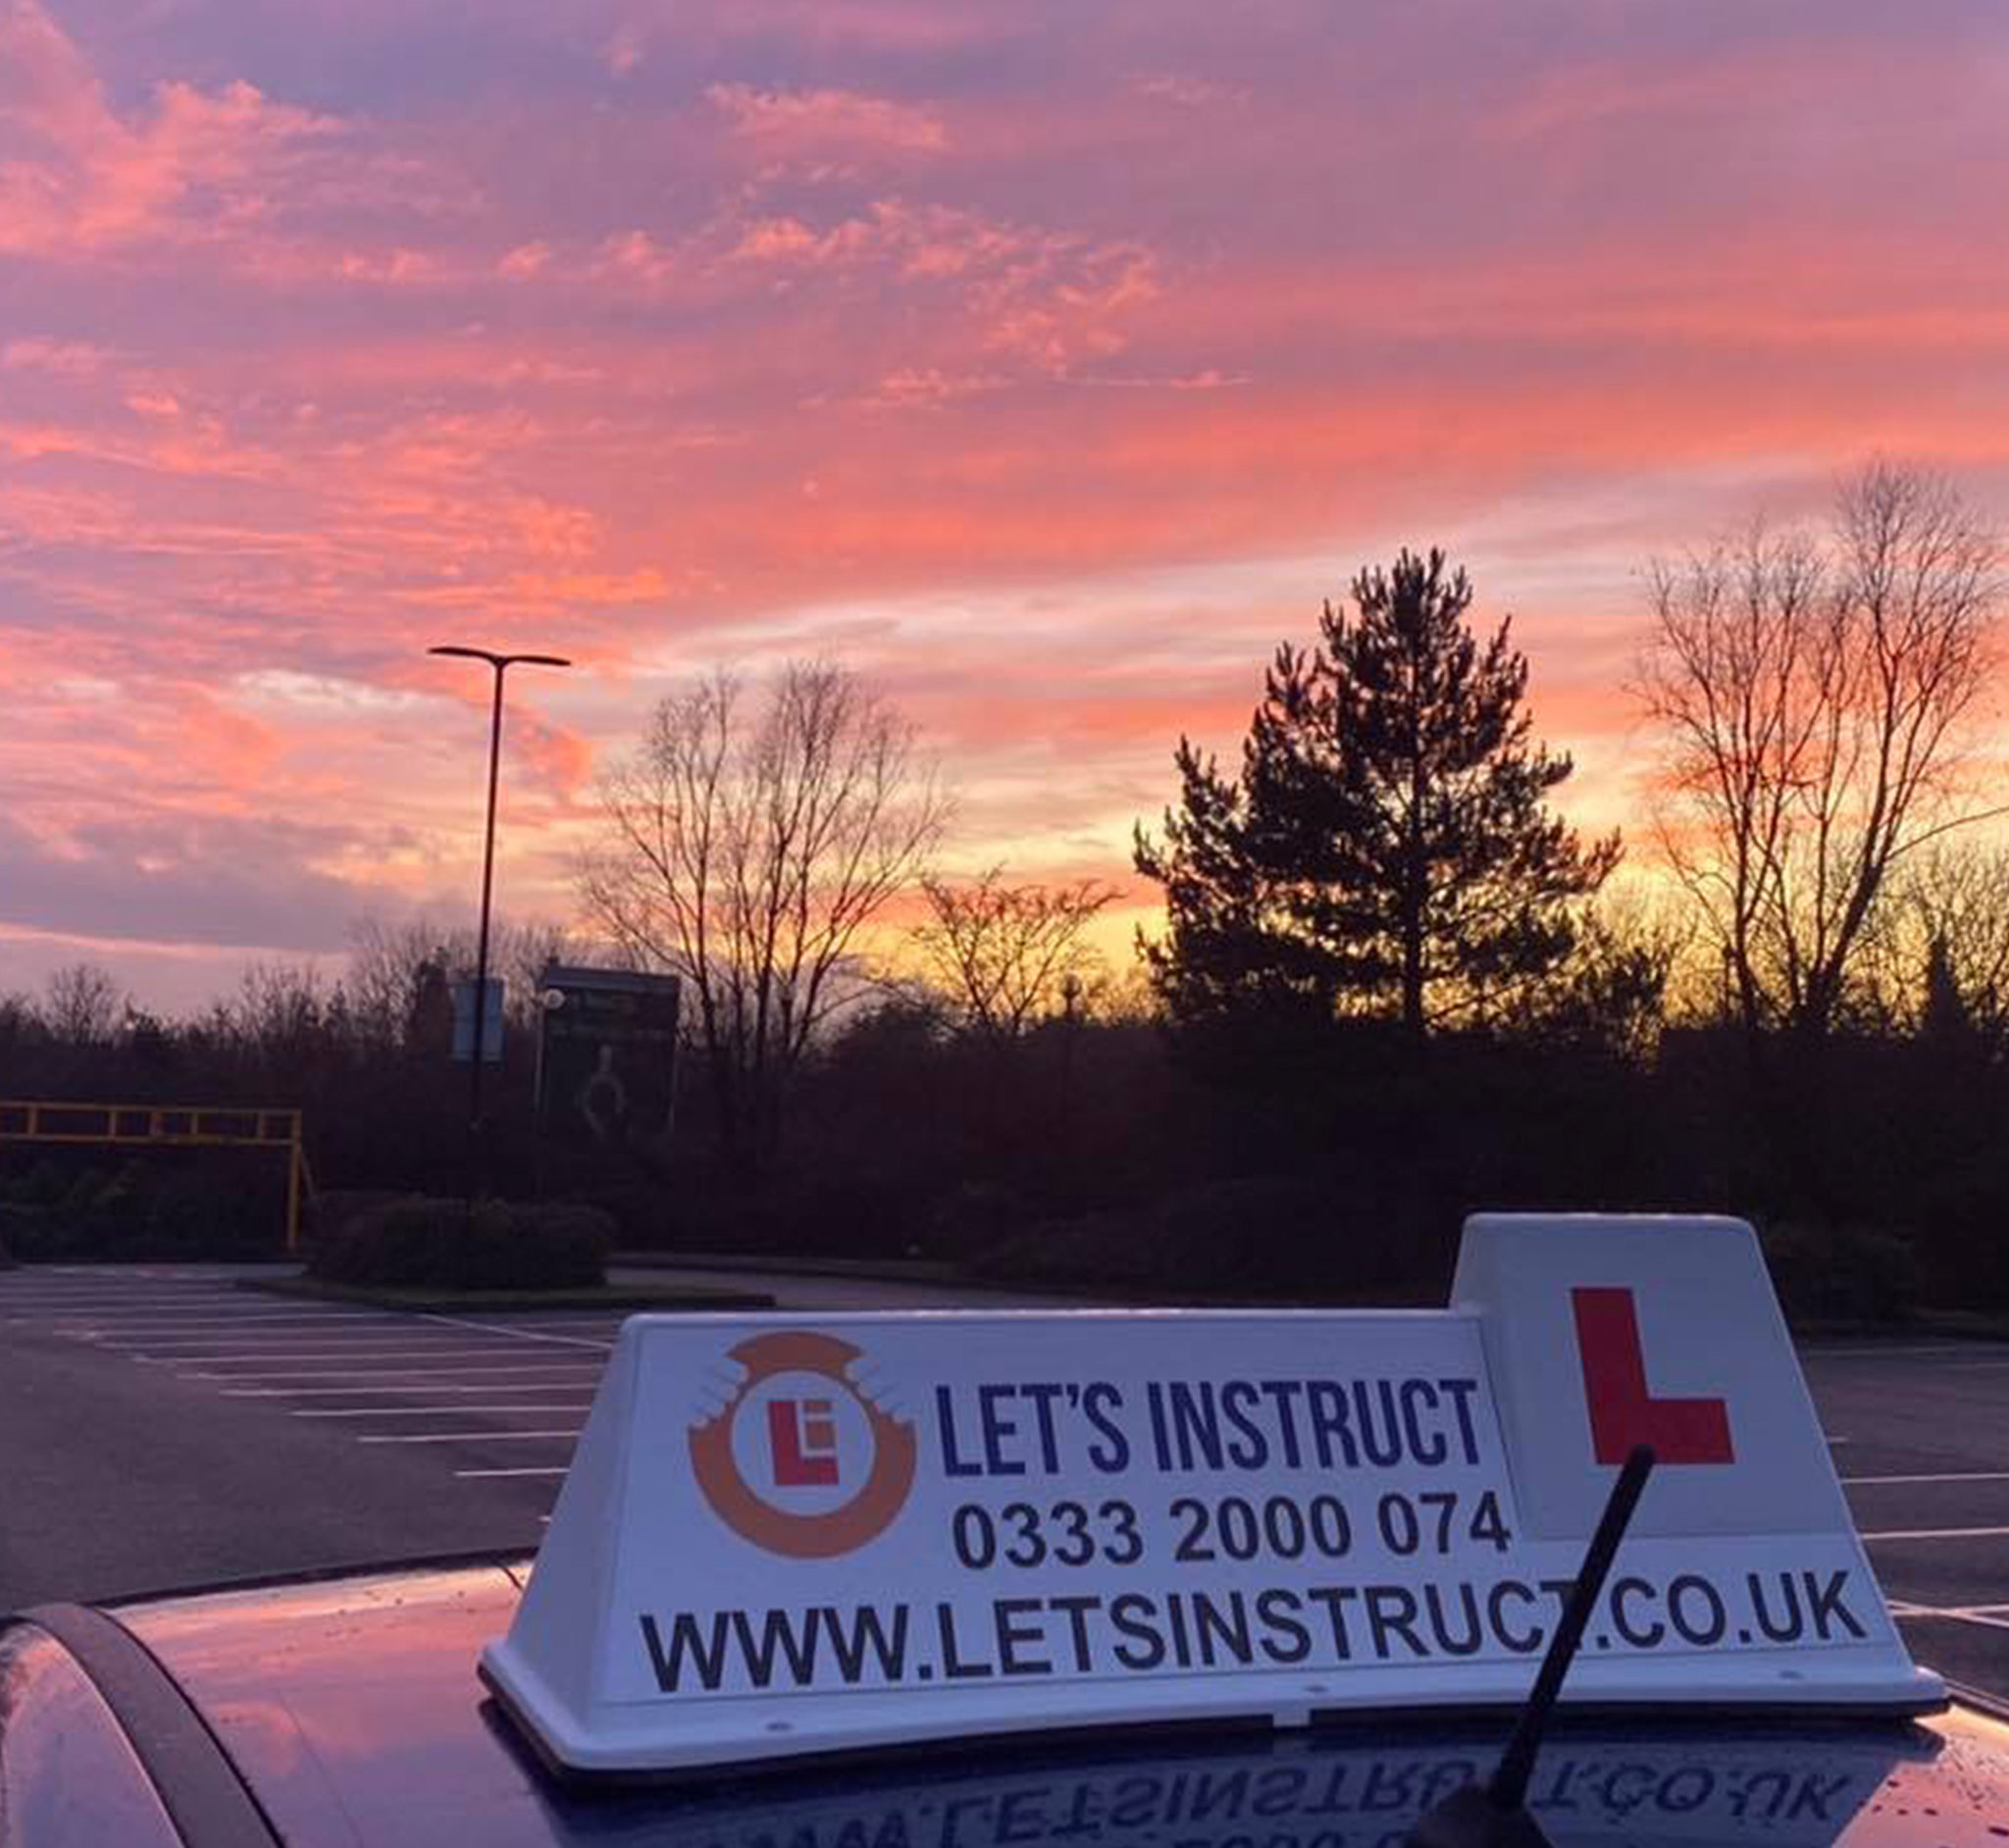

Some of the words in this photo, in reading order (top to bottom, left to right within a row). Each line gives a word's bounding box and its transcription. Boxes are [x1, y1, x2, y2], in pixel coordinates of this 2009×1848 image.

[1571, 1287, 1734, 1464] L
[936, 1381, 1130, 1476] LET'S
[1147, 1378, 1479, 1472] INSTRUCT
[953, 1501, 1144, 1569] 0333
[1169, 1495, 1352, 1562] 2000
[1377, 1491, 1512, 1556] 074
